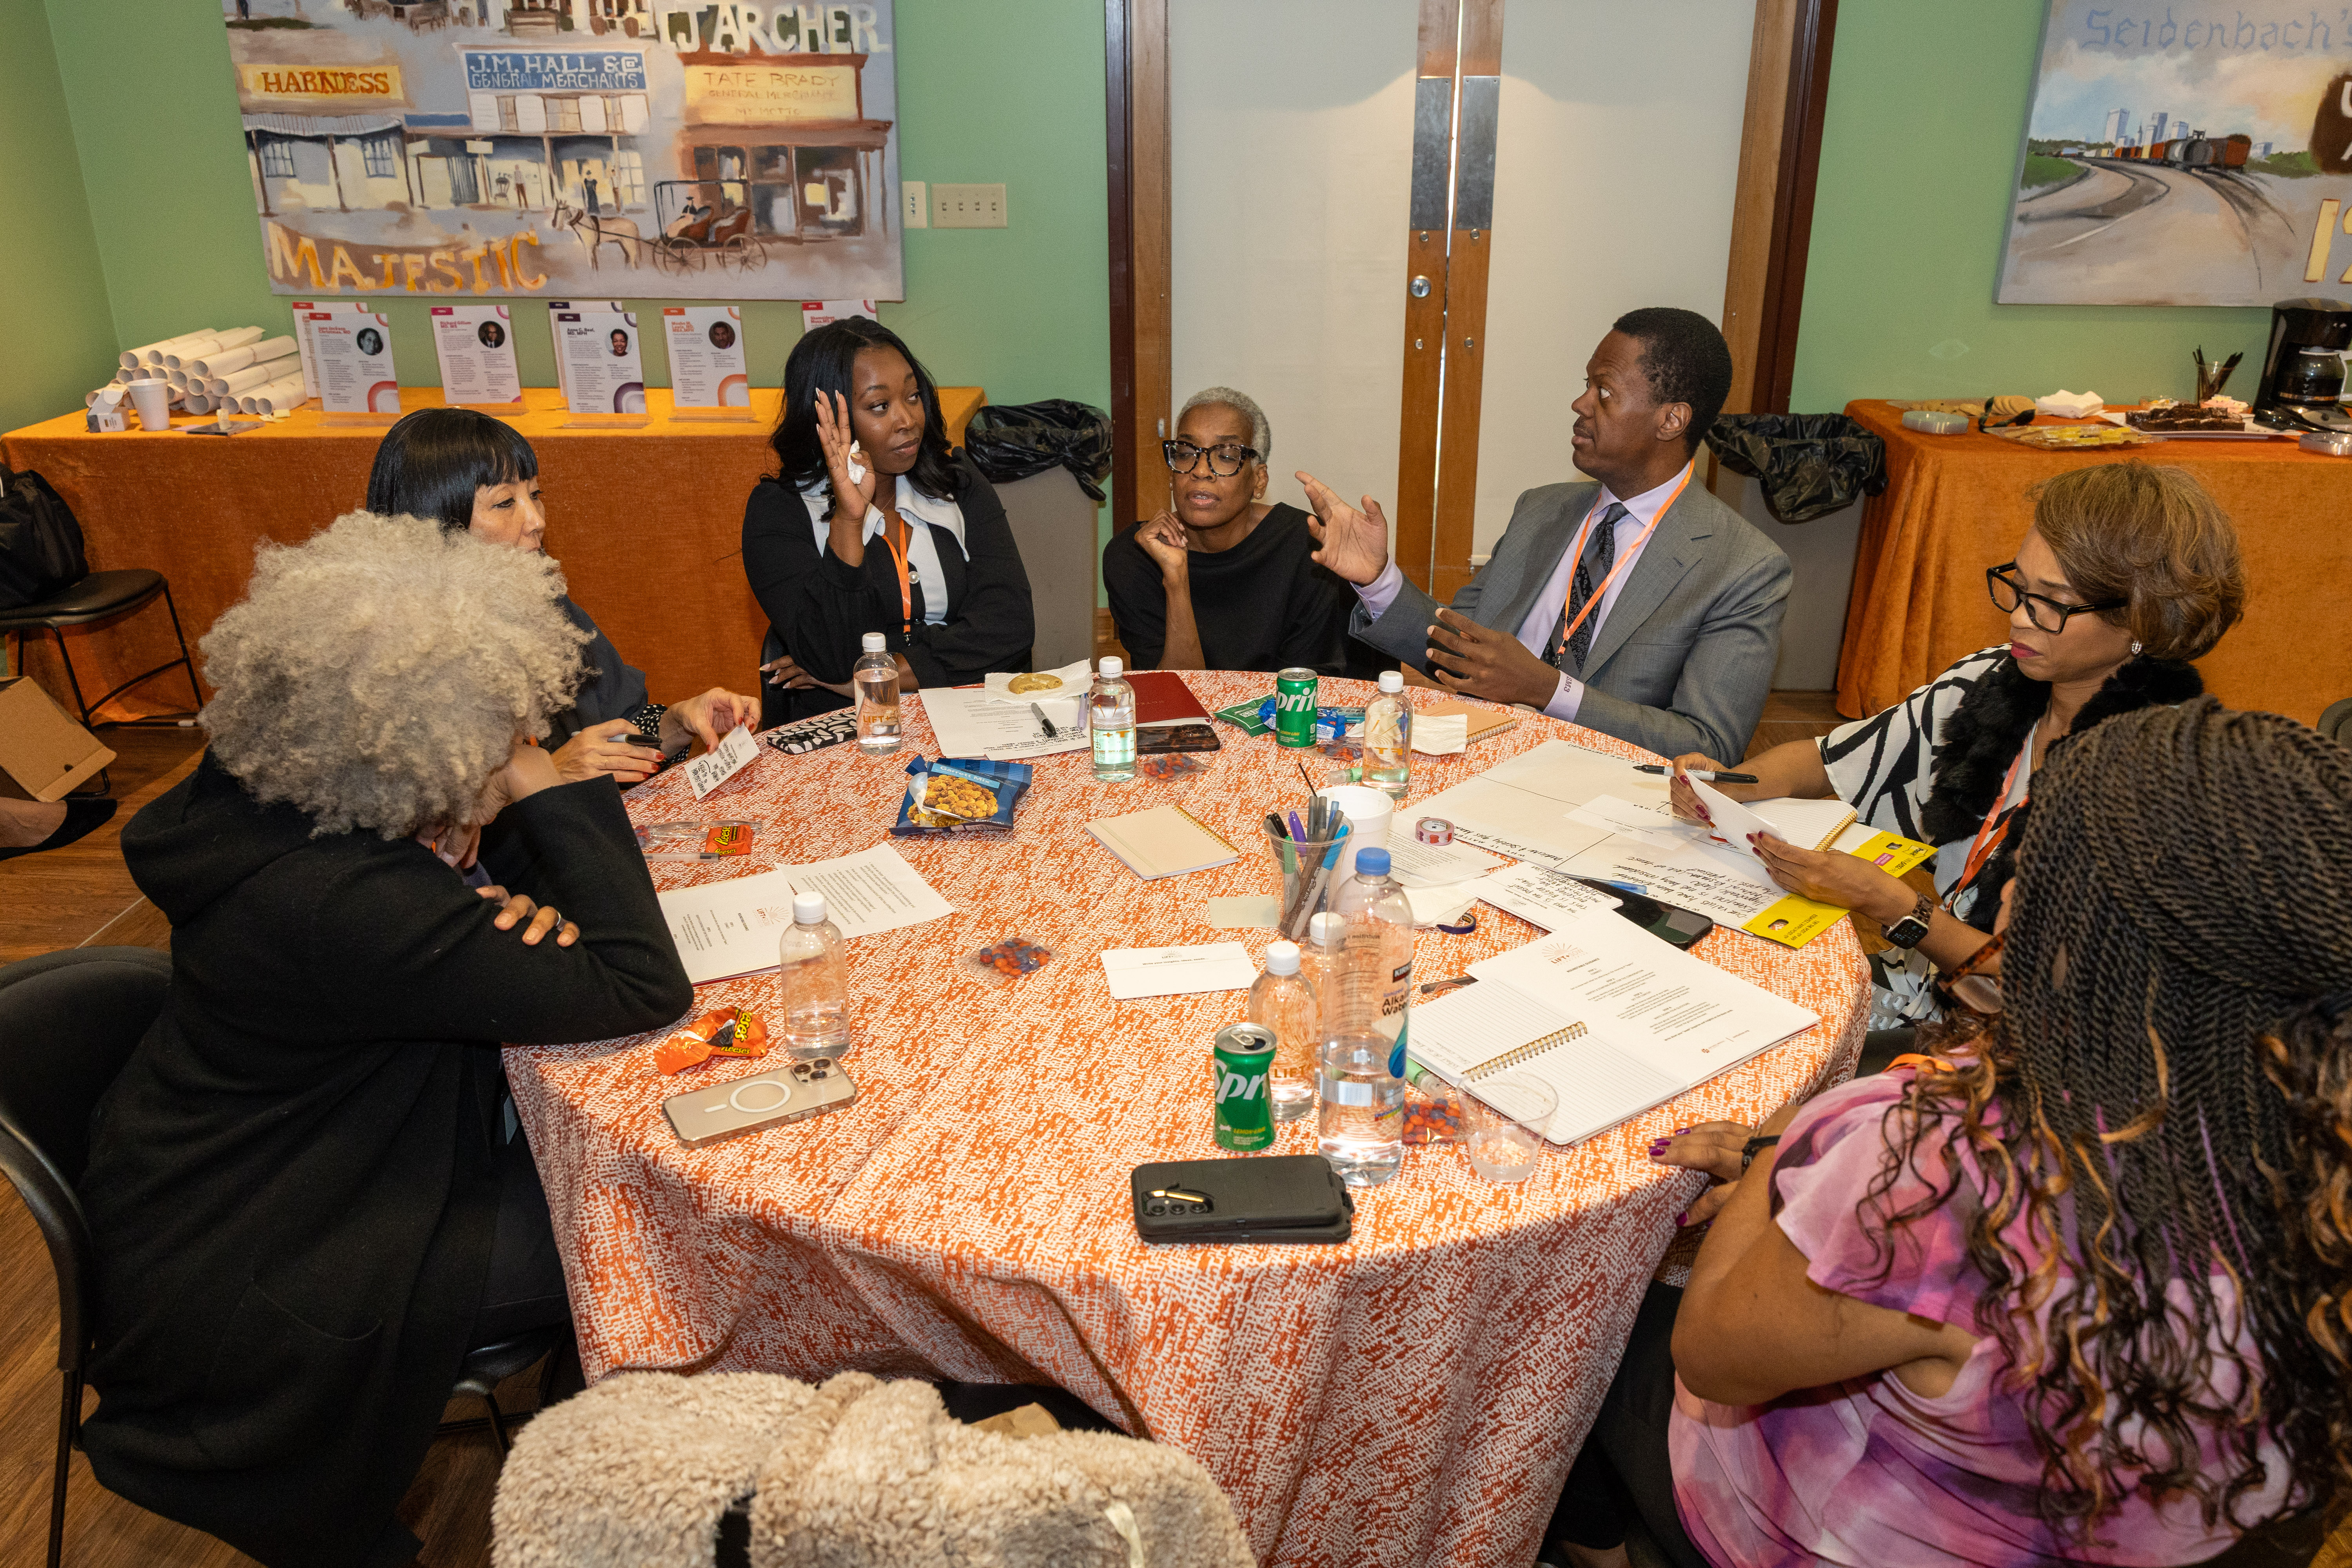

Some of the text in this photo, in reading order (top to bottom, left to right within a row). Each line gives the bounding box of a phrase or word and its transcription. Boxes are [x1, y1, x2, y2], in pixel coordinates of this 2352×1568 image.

[470, 55, 519, 73] J.M.
[523, 55, 596, 74] HALL
[262, 71, 390, 94] HARNESS
[472, 72, 639, 89] GENERAL MERCHANTS
[704, 72, 839, 87] TATE BRADY
[268, 221, 548, 295] MAJESTIC
[940, 766, 990, 784] Garrett Mix
[1451, 831, 1485, 843] MATTER
[1565, 957, 1600, 973] ROUNDTABLE GUIDANCE
